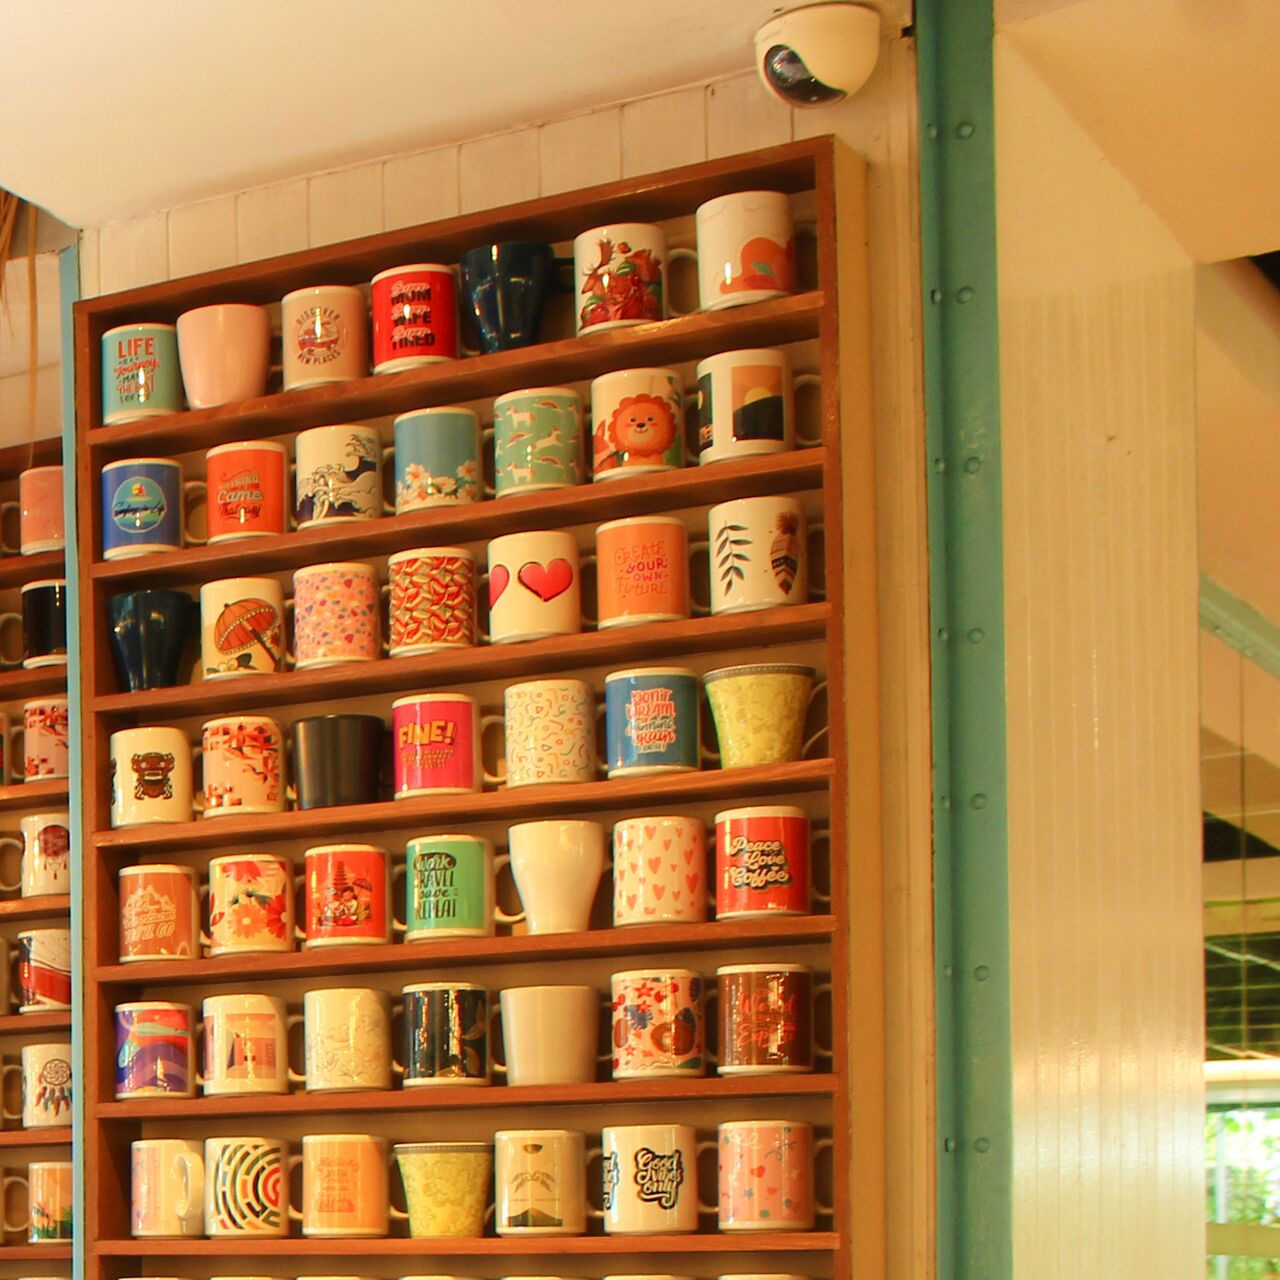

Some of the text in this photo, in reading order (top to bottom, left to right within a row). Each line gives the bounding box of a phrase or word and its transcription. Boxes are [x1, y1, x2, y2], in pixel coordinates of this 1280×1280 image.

[118, 337, 156, 359] LIFE
[218, 488, 264, 505] Came
[399, 720, 455, 749] FINE!
[729, 837, 780, 856] Peace
[745, 852, 785, 869] Love
[730, 870, 789, 888] Coffee
[642, 1180, 678, 1207] only
